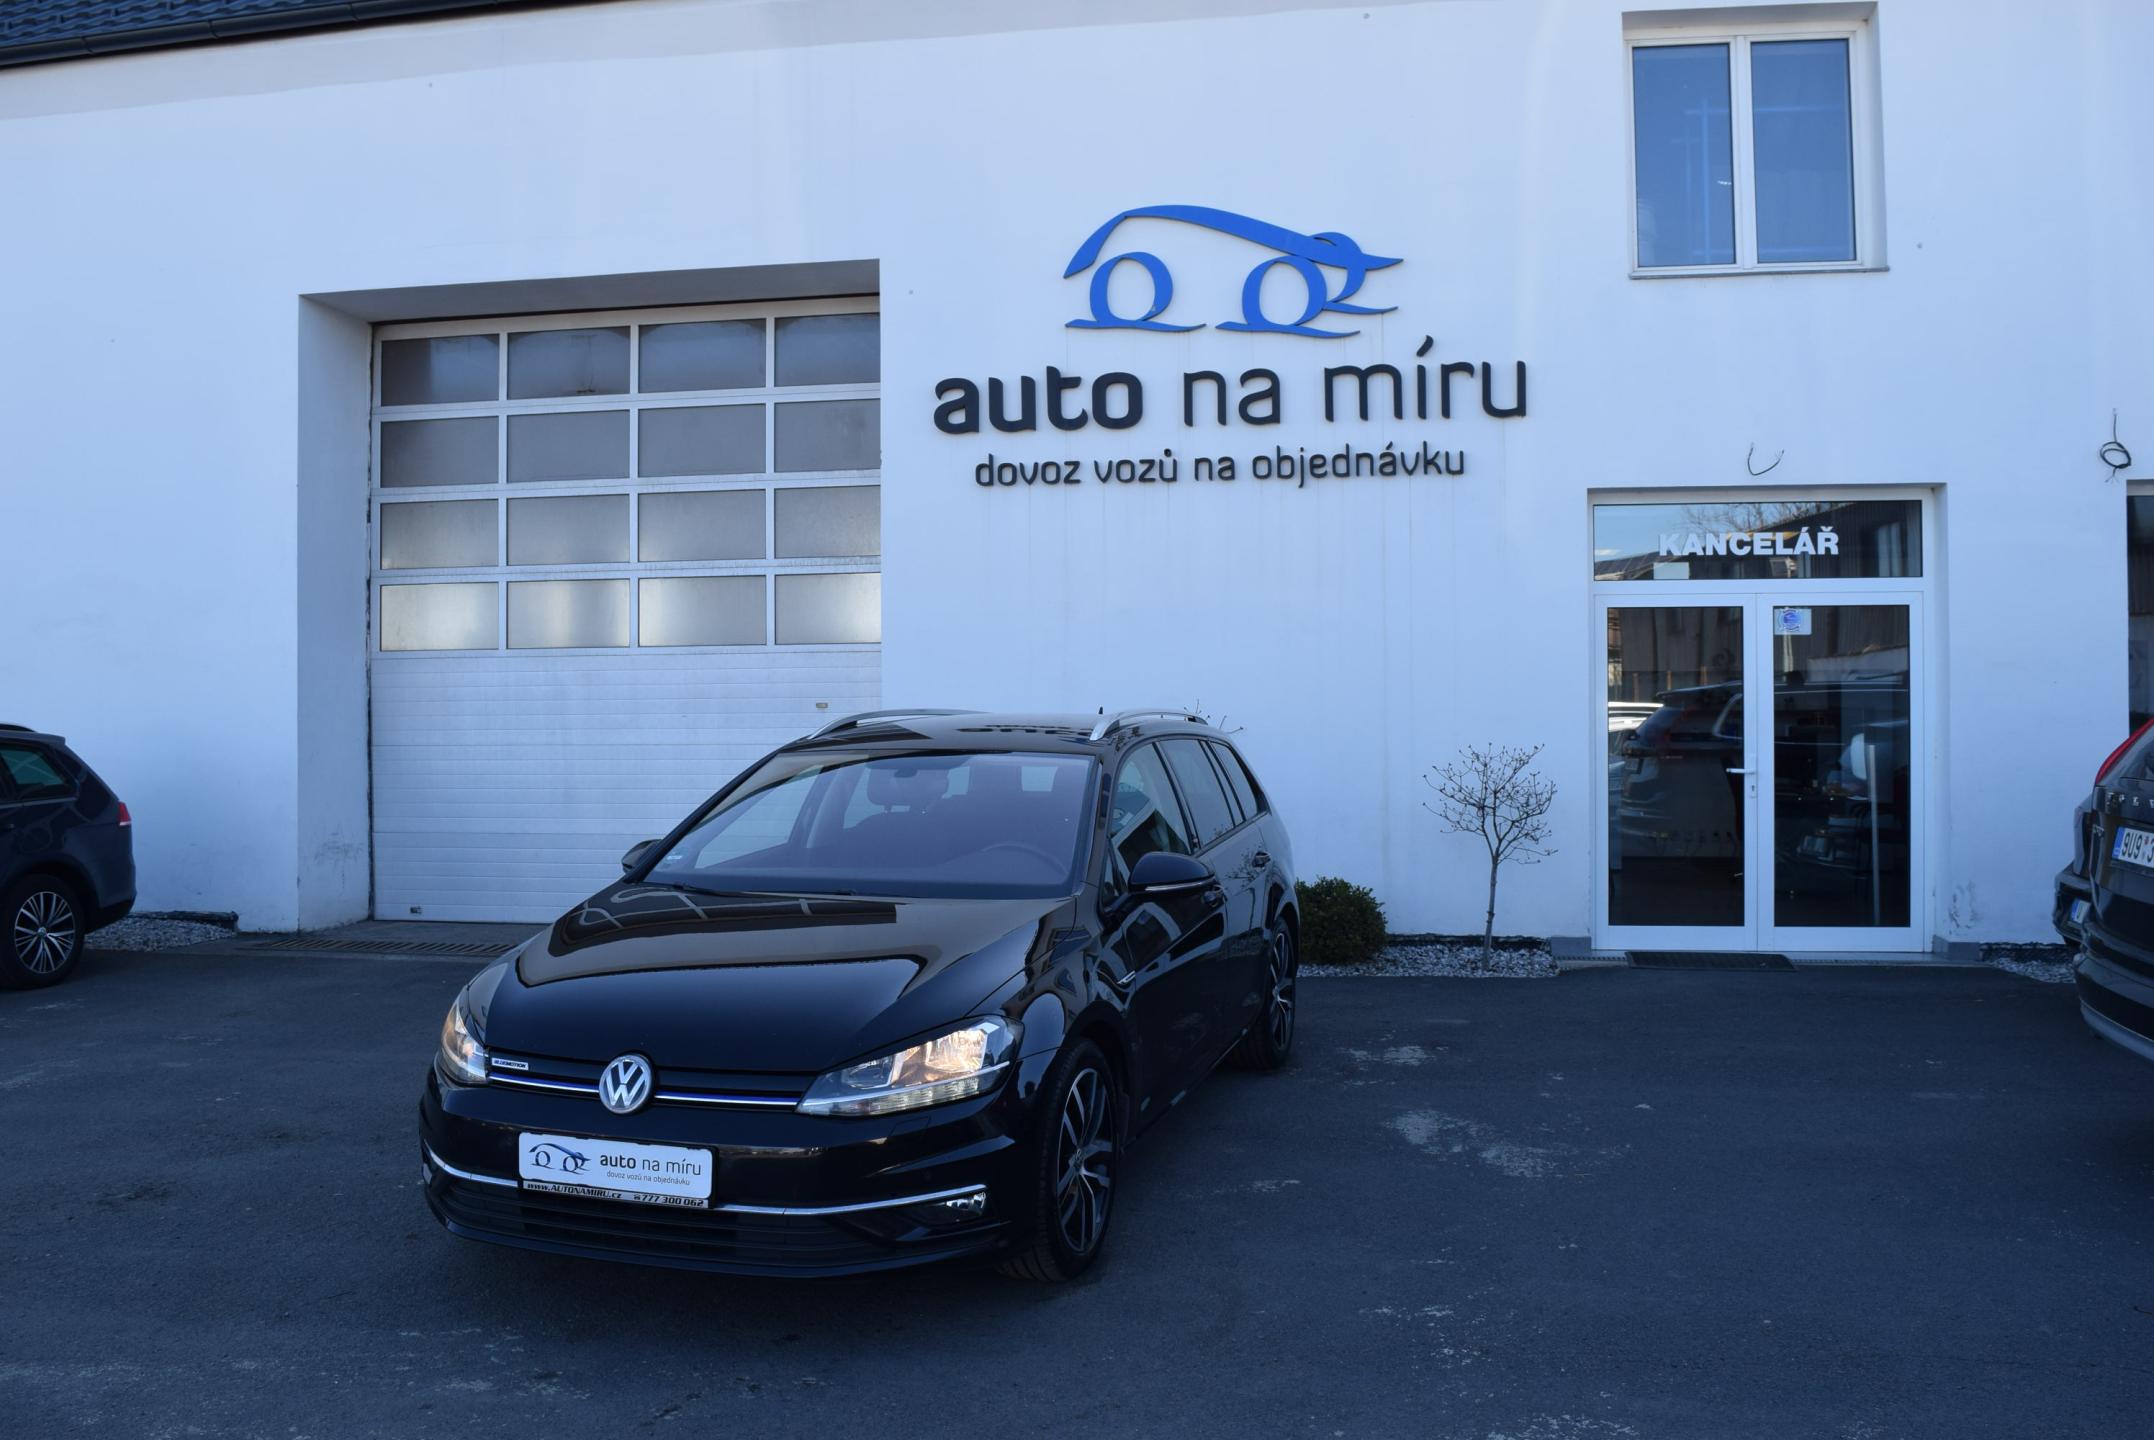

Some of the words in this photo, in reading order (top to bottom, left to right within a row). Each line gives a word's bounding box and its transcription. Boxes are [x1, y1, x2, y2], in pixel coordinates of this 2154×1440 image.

[934, 366, 1143, 434] auto
[1184, 368, 1281, 427] na
[1324, 335, 1527, 422] míru
[976, 454, 1081, 486] dovoz
[1094, 449, 1178, 483] vozů
[1195, 457, 1236, 481] na
[1252, 441, 1465, 488] objednávku
[1659, 526, 1838, 556] KANCELÁŘ
[2122, 832, 2142, 859] 9U9
[600, 1155, 636, 1169] auto
[642, 1159, 660, 1171] na
[666, 1158, 701, 1175] míru
[607, 1170, 625, 1179] dovoz
[653, 1176, 690, 1186] objednávku
[640, 1193, 660, 1202] 777
[662, 1196, 682, 1205] 300
[684, 1198, 704, 1207] 062
